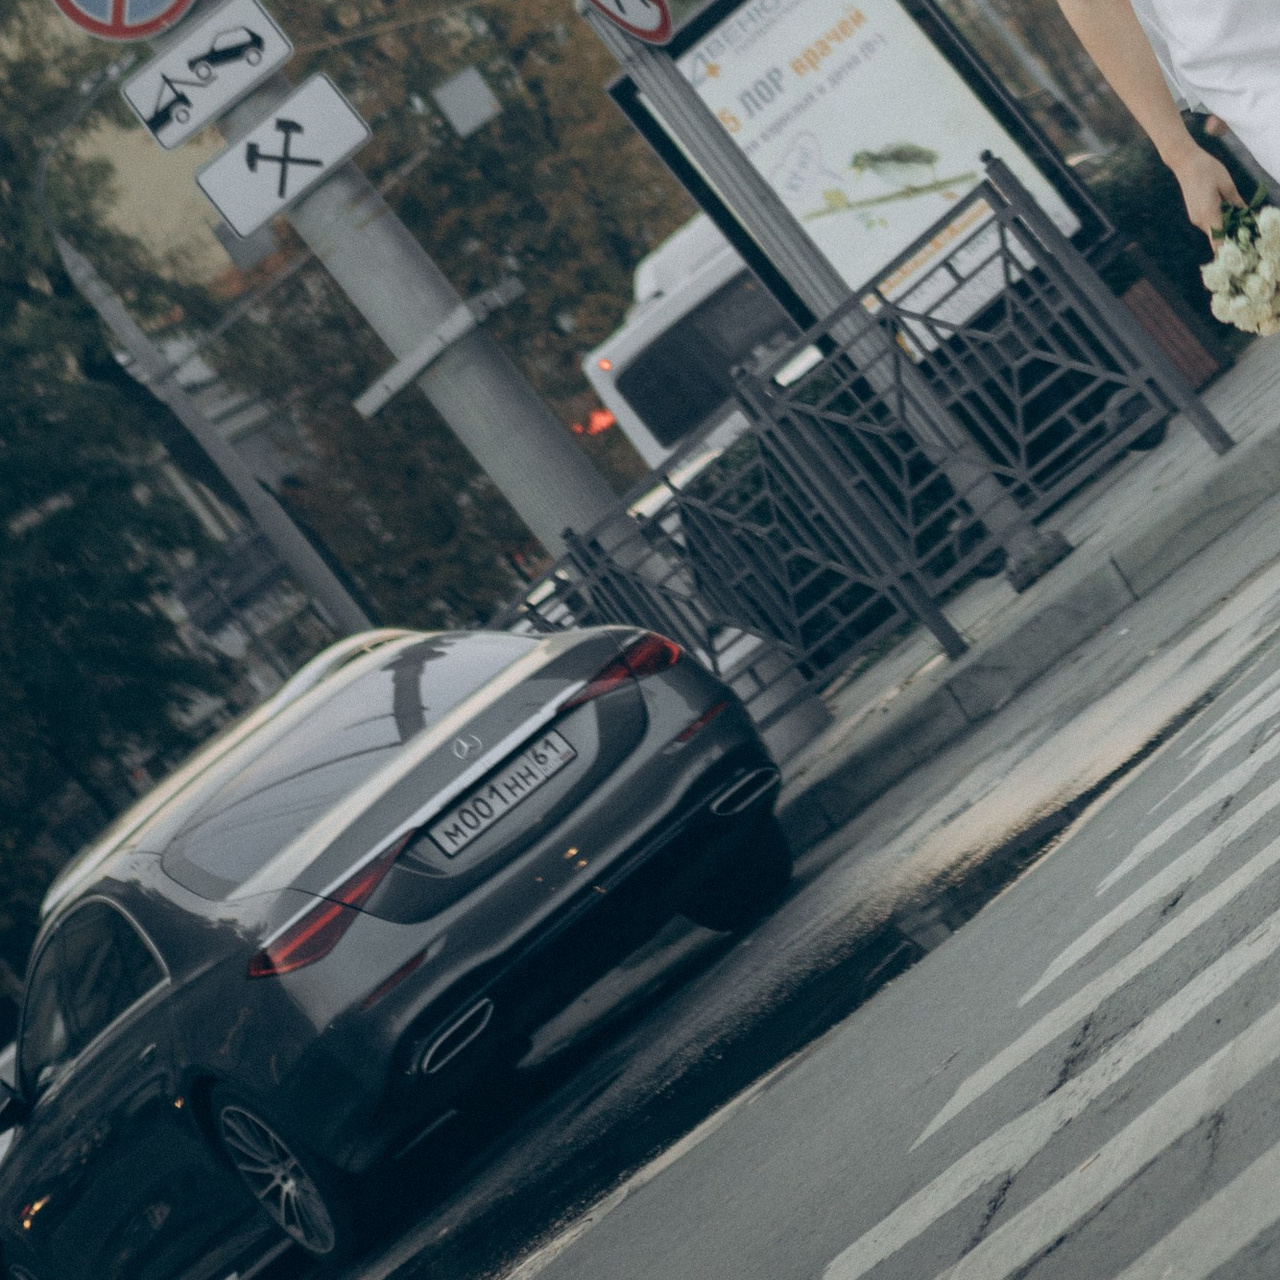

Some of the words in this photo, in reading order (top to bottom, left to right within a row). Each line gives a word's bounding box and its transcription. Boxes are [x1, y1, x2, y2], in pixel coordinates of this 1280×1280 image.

[738, 66, 784, 119] ЛОР
[789, 3, 867, 77] врачей
[531, 739, 560, 765] 61
